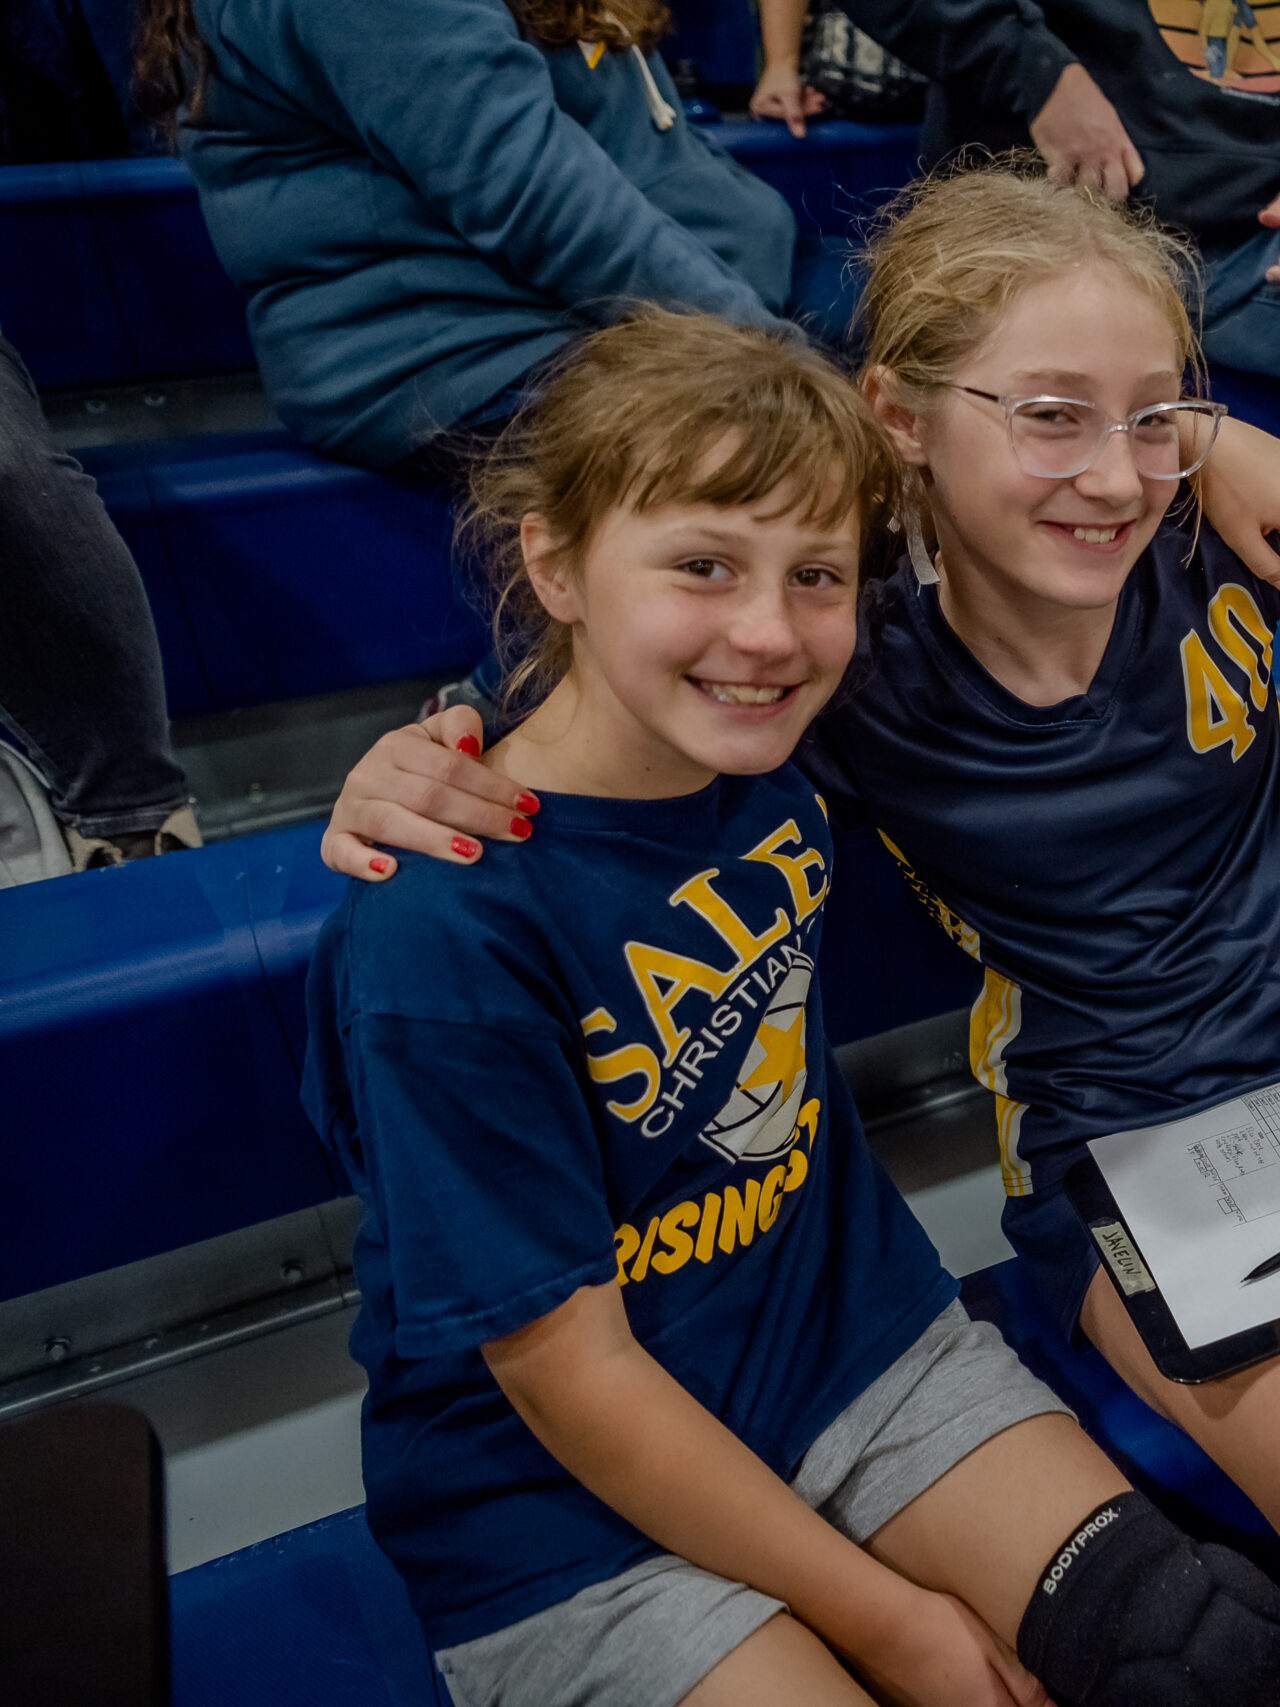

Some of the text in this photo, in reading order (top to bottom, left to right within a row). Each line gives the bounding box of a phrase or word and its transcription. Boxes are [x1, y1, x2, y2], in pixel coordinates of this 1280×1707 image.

[1180, 582, 1273, 764] 40
[581, 793, 834, 1124] SALE
[640, 933, 803, 1139] CHRISTIAN
[614, 1164, 787, 1287] RISING
[1102, 1231, 1142, 1275] JAVELIN
[1043, 1507, 1119, 1595] BODYPROX
